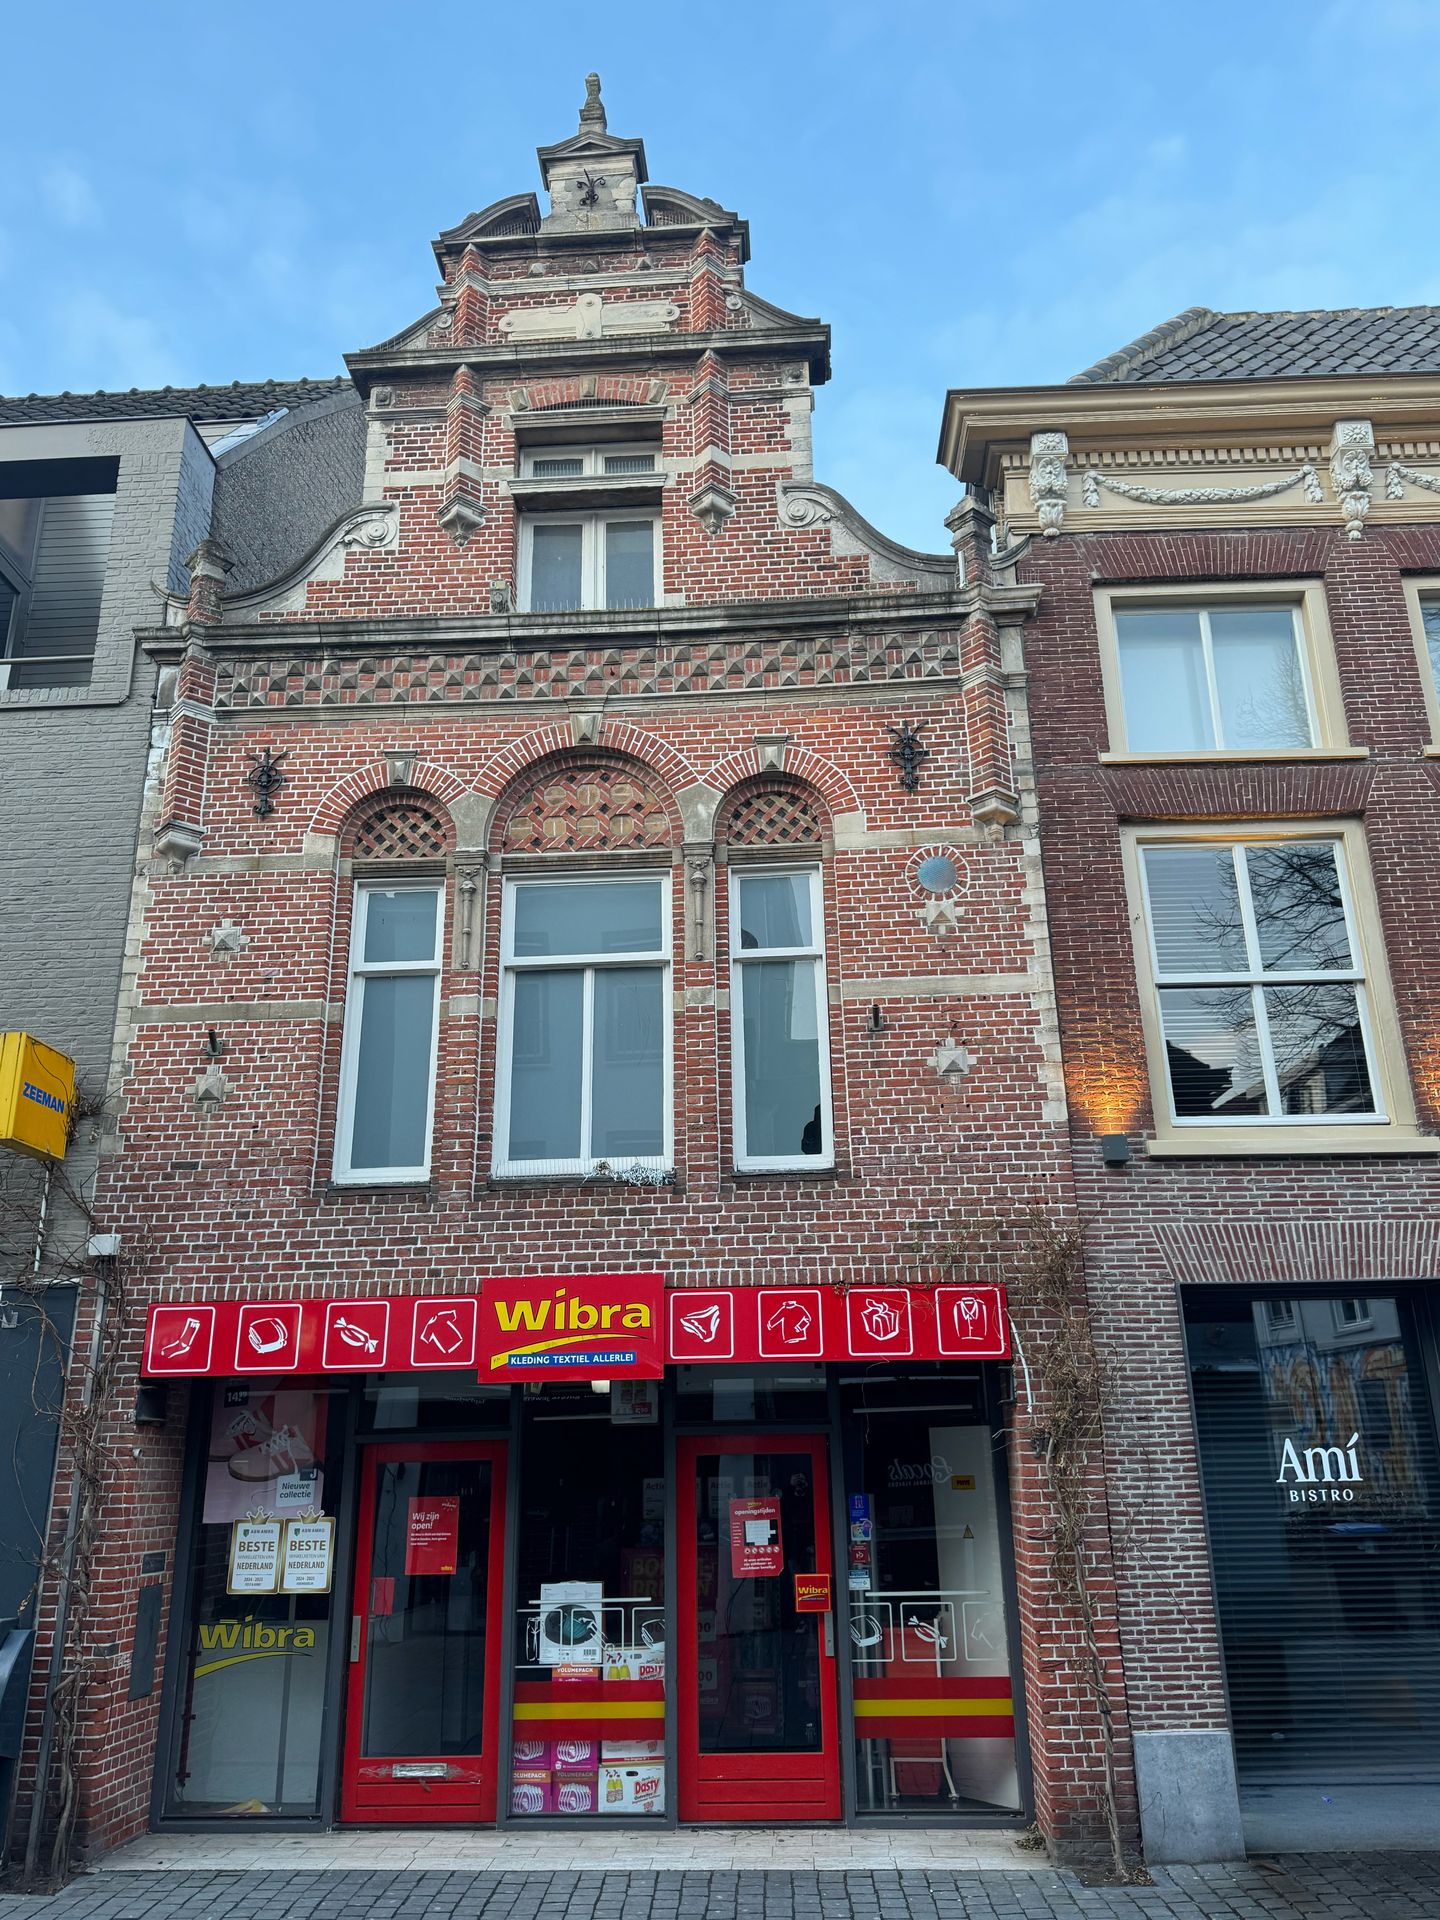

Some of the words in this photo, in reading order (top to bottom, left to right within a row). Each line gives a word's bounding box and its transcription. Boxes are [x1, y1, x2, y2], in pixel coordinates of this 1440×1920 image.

[23, 1082, 64, 1114] ZEEMAN
[494, 1288, 650, 1331] Wibra
[510, 1356, 550, 1365] KLEDING
[553, 1355, 589, 1364] TEXTIEL
[593, 1353, 633, 1362] ALLERLEI
[1276, 1432, 1363, 1482] Amí
[281, 1482, 310, 1490] Nieuwe
[280, 1490, 311, 1498] collectie
[1290, 1489, 1354, 1502] BISTRO
[412, 1512, 425, 1521] Wij
[426, 1512, 440, 1521] zijn
[734, 1506, 776, 1516] openingstijden
[411, 1521, 433, 1531] open!
[238, 1541, 275, 1552] BESTE
[290, 1540, 326, 1551] BESTE
[236, 1562, 274, 1570] NEDERLAND
[288, 1561, 325, 1569] NEDERLAND
[798, 1585, 828, 1594] Wibra
[199, 1615, 315, 1648] Wibra
[633, 1778, 660, 1795] Dasty
